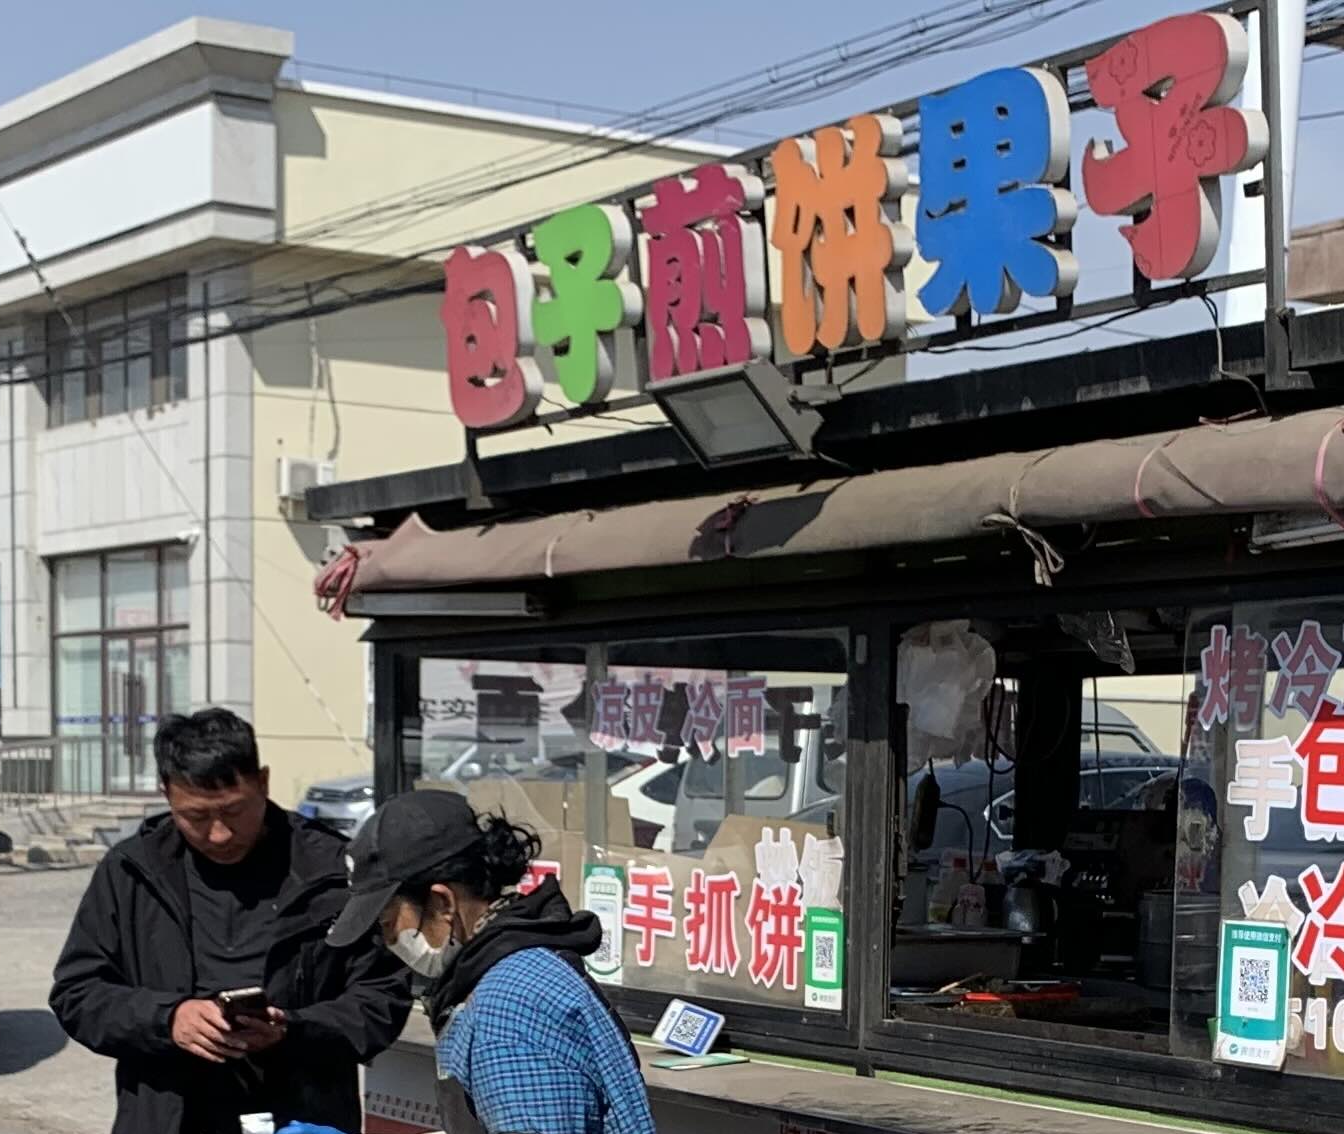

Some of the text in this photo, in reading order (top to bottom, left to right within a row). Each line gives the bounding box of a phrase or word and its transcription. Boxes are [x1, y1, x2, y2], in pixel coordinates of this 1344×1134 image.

[441, 12, 1258, 428] 包子煎饼果子
[623, 866, 806, 990] 手抓饼
